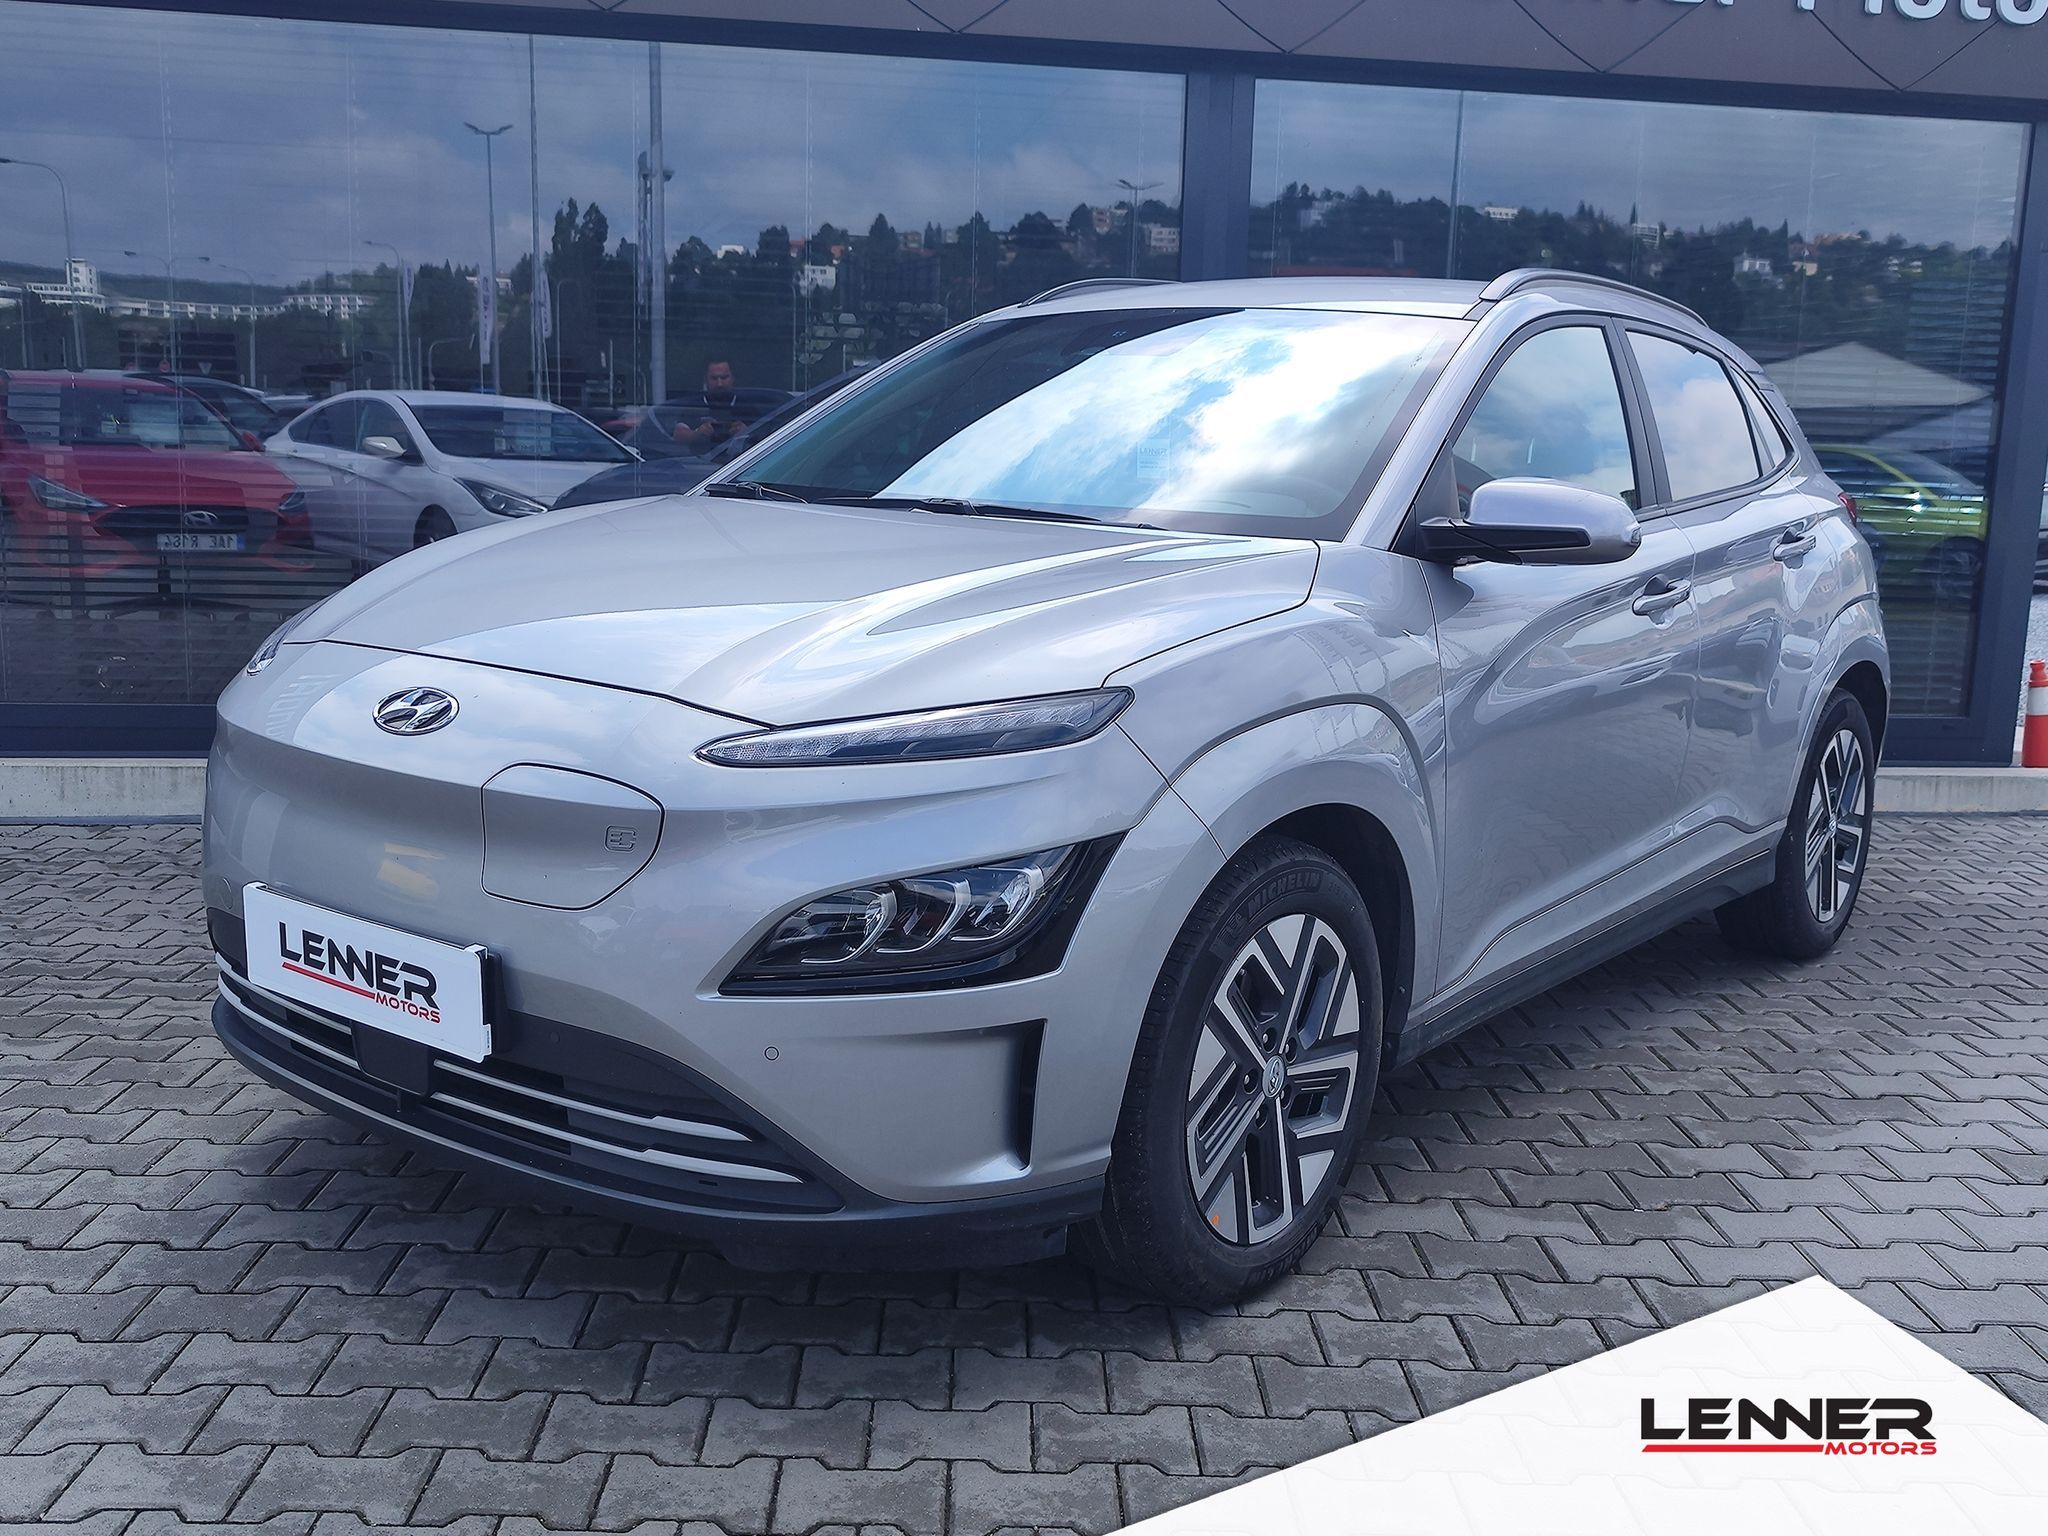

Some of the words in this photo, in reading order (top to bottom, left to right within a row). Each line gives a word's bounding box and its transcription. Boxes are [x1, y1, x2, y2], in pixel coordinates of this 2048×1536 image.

[1247, 871, 1321, 922] MICHELIN
[278, 921, 441, 1011] LENNER
[375, 991, 441, 1024] MOTORS
